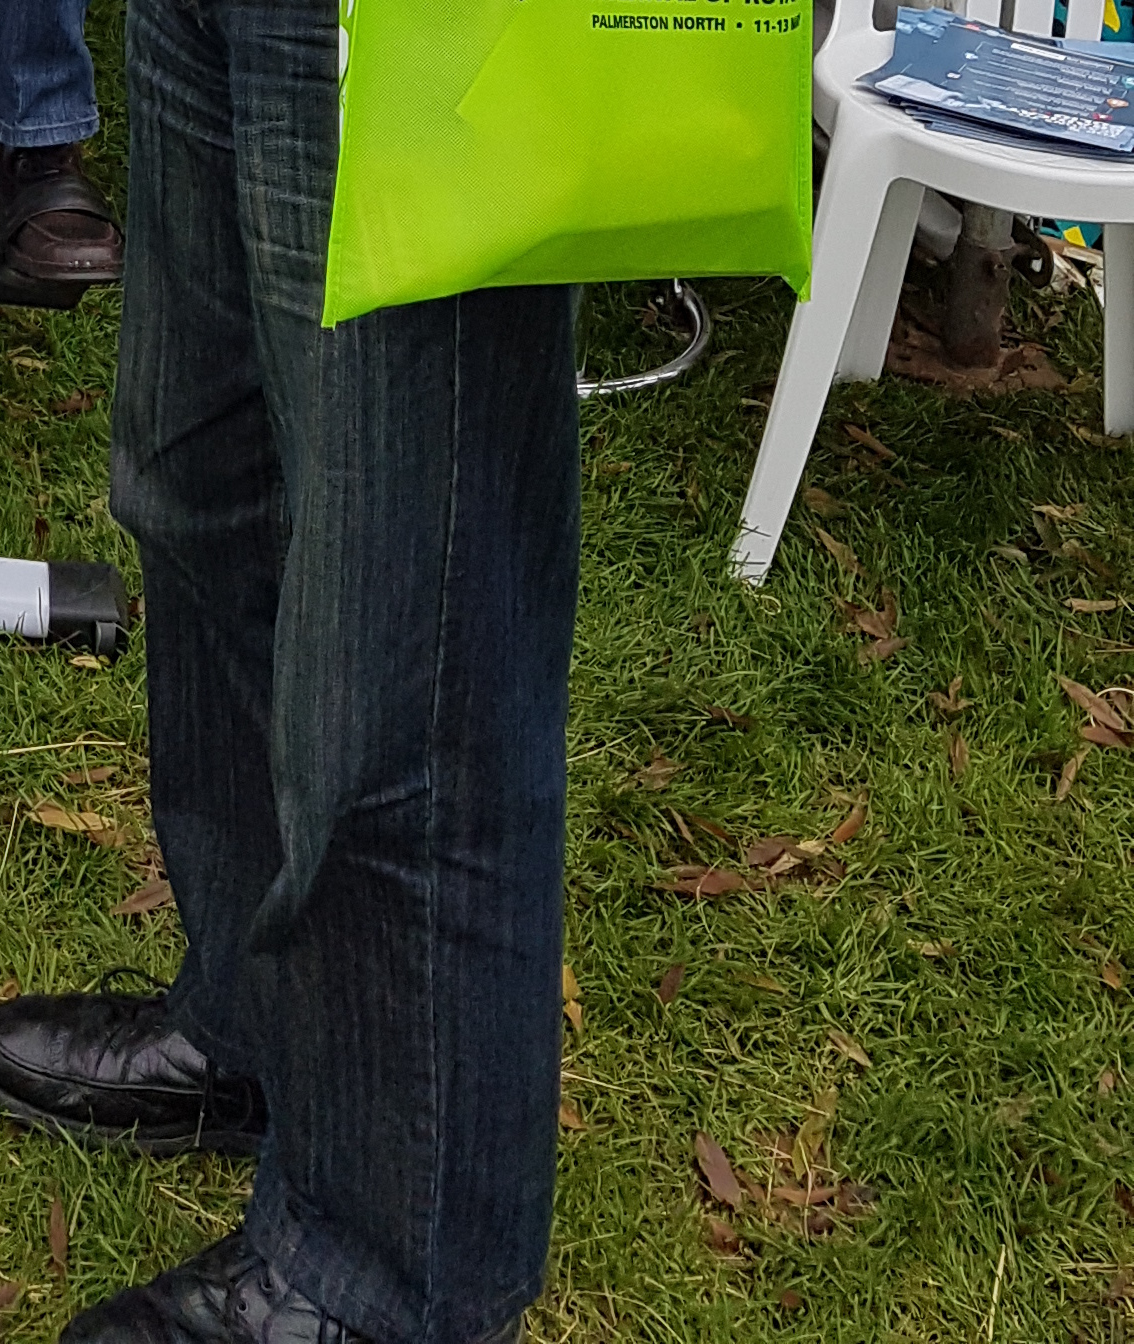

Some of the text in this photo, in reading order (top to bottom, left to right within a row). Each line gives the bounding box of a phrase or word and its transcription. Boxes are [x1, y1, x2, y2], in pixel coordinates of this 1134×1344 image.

[592, 14, 669, 30] PALMERSTON
[673, 16, 725, 32] NORTH
[754, 18, 789, 34] 11-13
